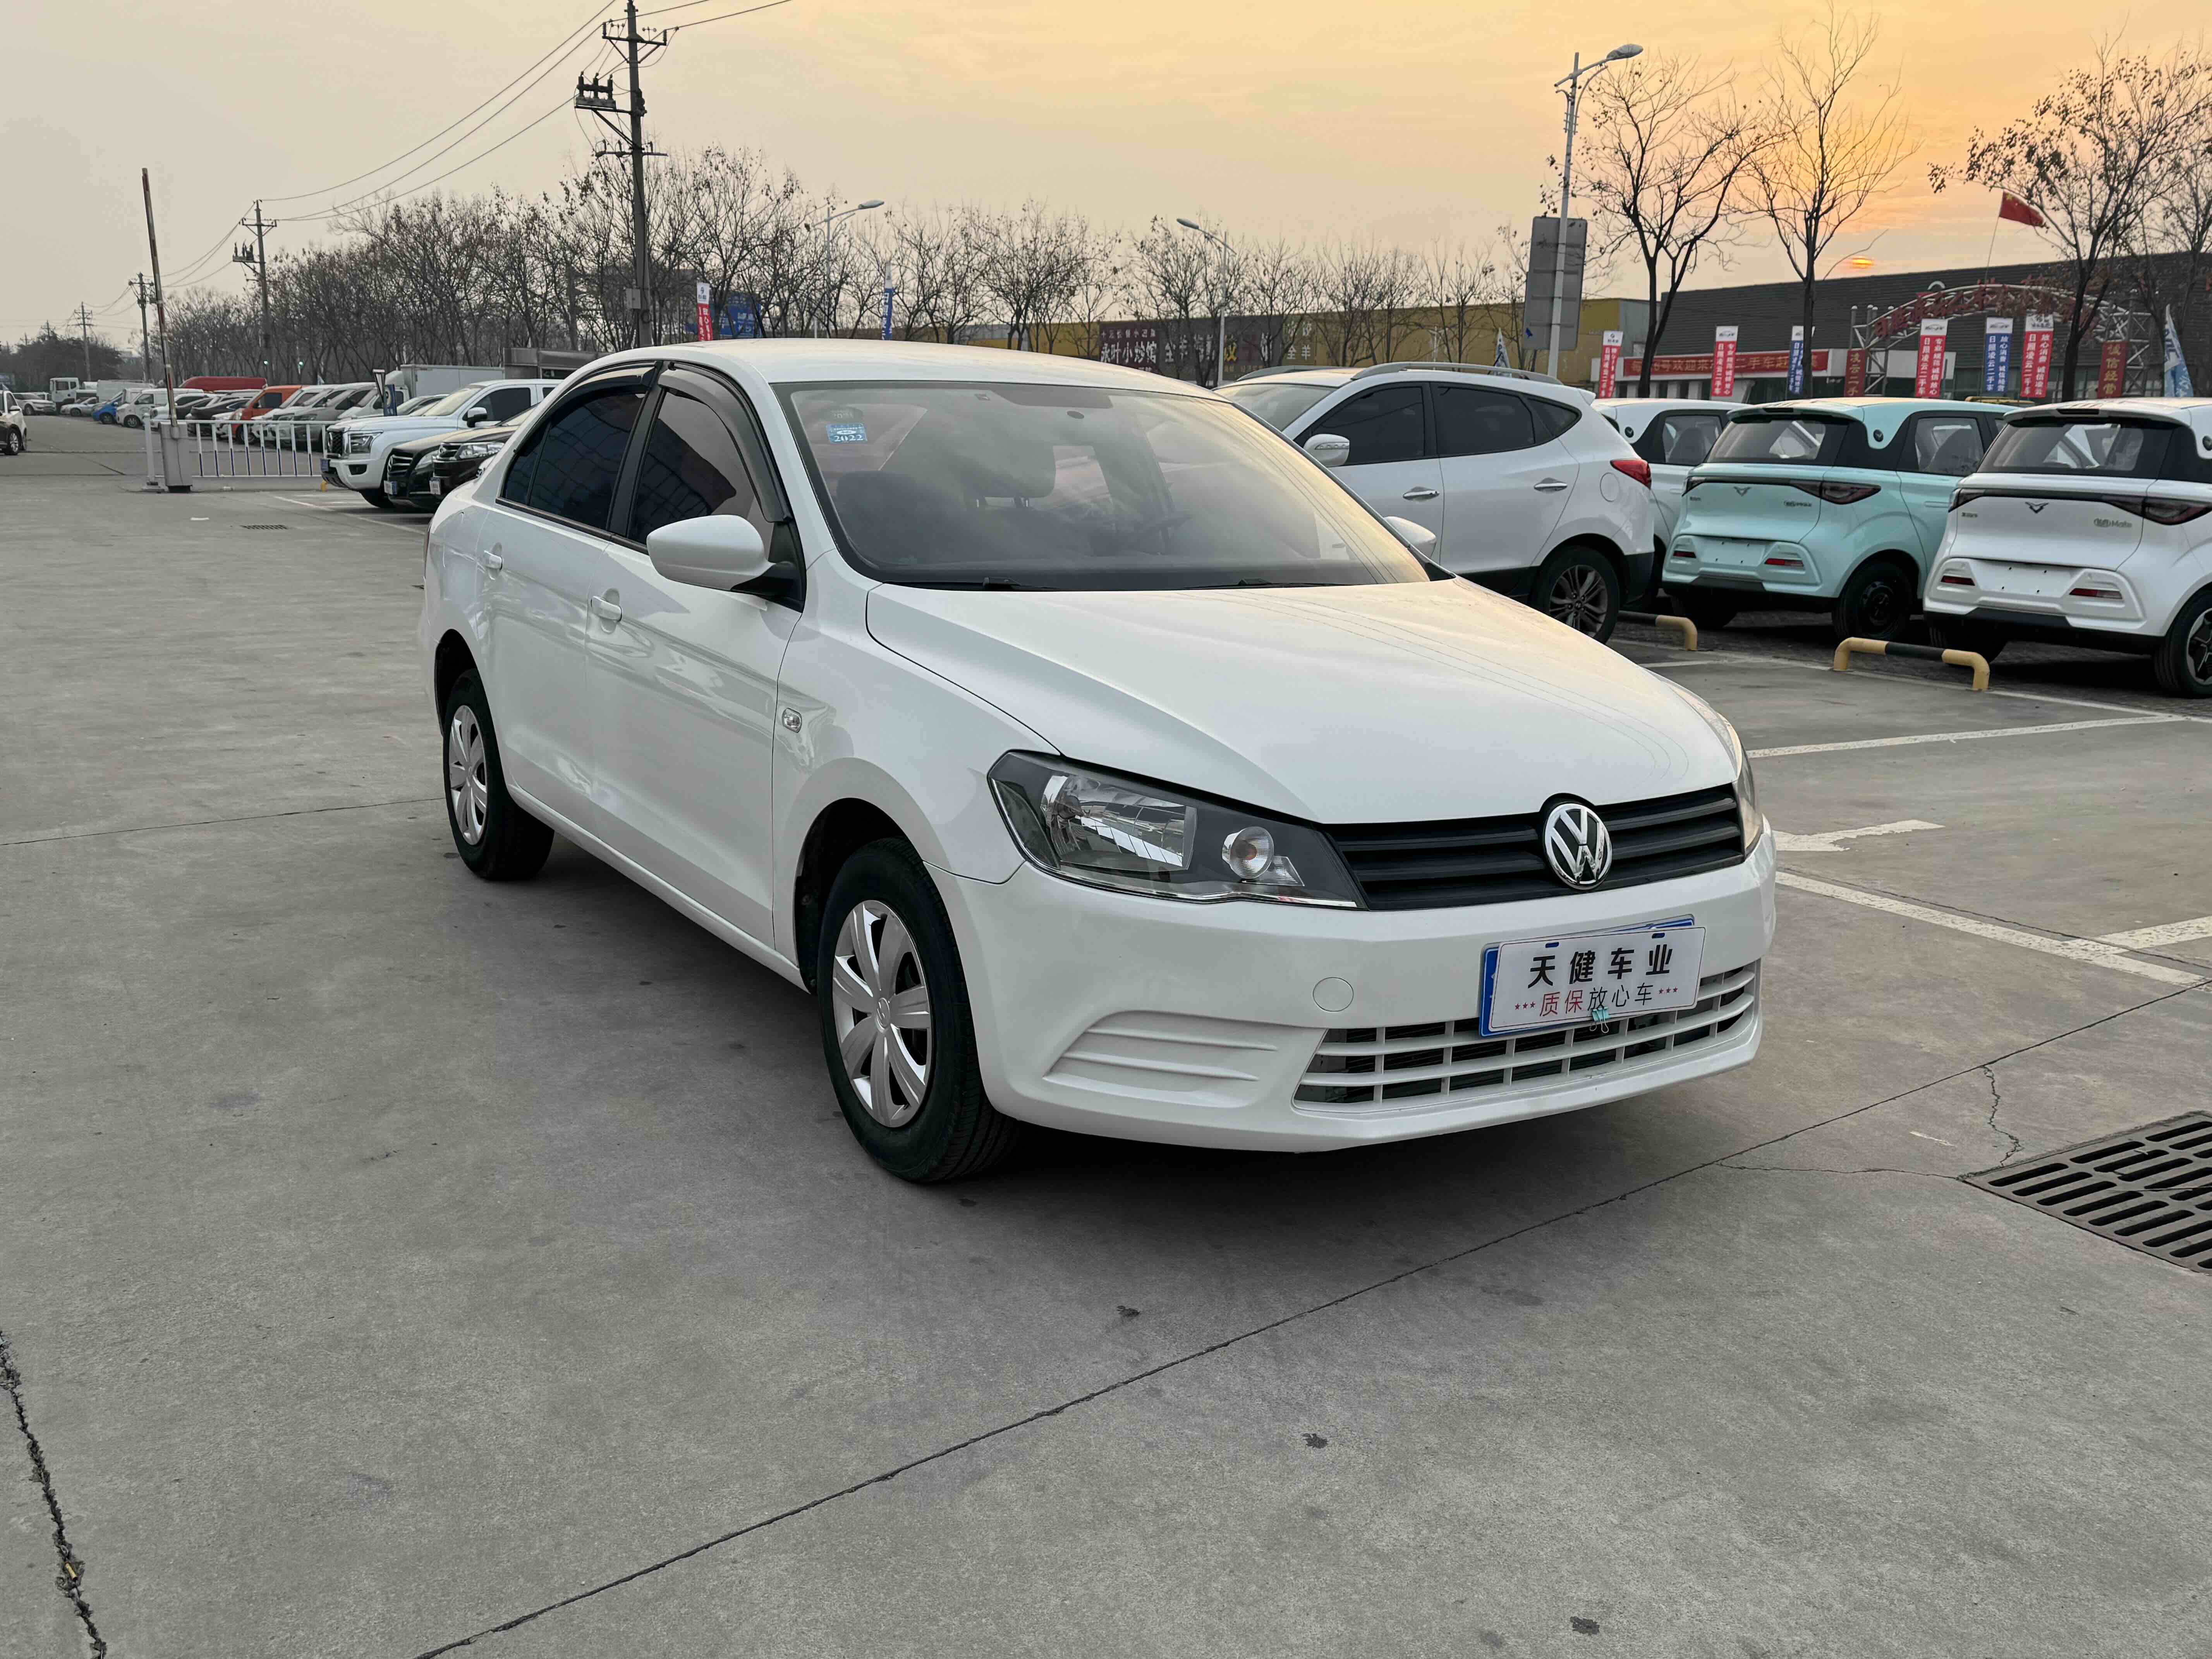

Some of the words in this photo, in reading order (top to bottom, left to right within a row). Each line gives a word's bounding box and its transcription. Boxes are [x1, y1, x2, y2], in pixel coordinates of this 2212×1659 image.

[1527, 944, 1673, 989] 天健车业
[1539, 982, 1654, 1017] 质保放心车
